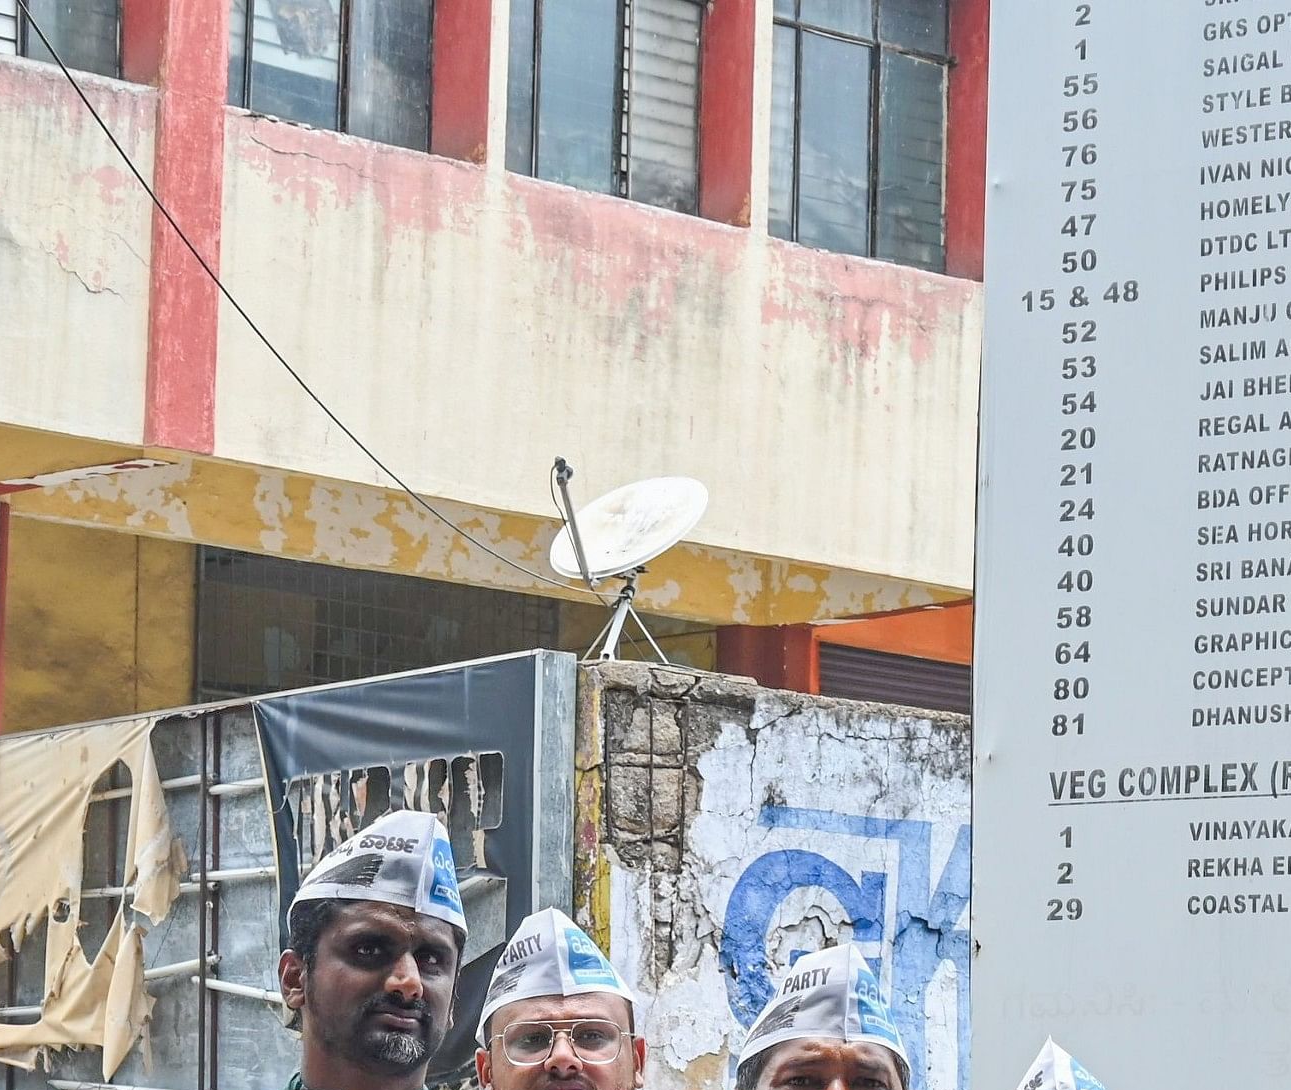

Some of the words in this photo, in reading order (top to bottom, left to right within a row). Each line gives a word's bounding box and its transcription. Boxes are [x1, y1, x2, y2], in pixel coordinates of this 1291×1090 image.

[1075, 5, 1090, 26] 2
[1075, 39, 1086, 60] 1
[1204, 19, 1247, 41] GKS
[1064, 73, 1098, 97] 55
[1204, 50, 1283, 77] SAIGAL
[1063, 109, 1097, 132] 56
[1203, 87, 1271, 113] STYLE
[1062, 144, 1097, 167] 76
[1061, 179, 1096, 202] 75
[1201, 161, 1250, 185] IVAN
[1061, 214, 1096, 237] 47
[1201, 192, 1290, 220] HOMELY
[1062, 249, 1096, 273] 50
[1201, 233, 1257, 257] DTDC
[1021, 288, 1056, 313] 15
[1069, 286, 1089, 307] &
[1103, 280, 1138, 303] 48
[1201, 266, 1286, 292] PHILIPS
[1062, 320, 1096, 344] 52
[1201, 303, 1276, 328] MANJU
[1062, 356, 1096, 379] 53
[1200, 340, 1265, 365] SALIM
[1062, 391, 1096, 415] 54
[1200, 380, 1233, 401] JAI
[1061, 427, 1095, 450] 20
[1199, 414, 1270, 437] REGAL
[1060, 462, 1092, 486] 21
[1059, 498, 1095, 522] 24
[1198, 488, 1240, 509] BDA
[1058, 534, 1093, 557] 40
[1198, 525, 1238, 545] SEA
[1057, 570, 1092, 592] 40
[1196, 561, 1230, 582] SRI
[1057, 606, 1091, 629] 58
[1196, 594, 1285, 617] SUNDAR
[1055, 641, 1091, 664] 64
[1054, 677, 1089, 700] 80
[1052, 713, 1084, 736] 81
[1049, 769, 1105, 800] VEG
[1119, 762, 1258, 797] COMPLEX
[1060, 826, 1071, 848] 1
[1057, 863, 1073, 884] 2
[1188, 857, 1263, 878] REKHA
[1047, 898, 1082, 921] 29
[1188, 894, 1288, 915] COASTAL
[502, 932, 544, 966] PARTY
[782, 967, 832, 995] PARTY
